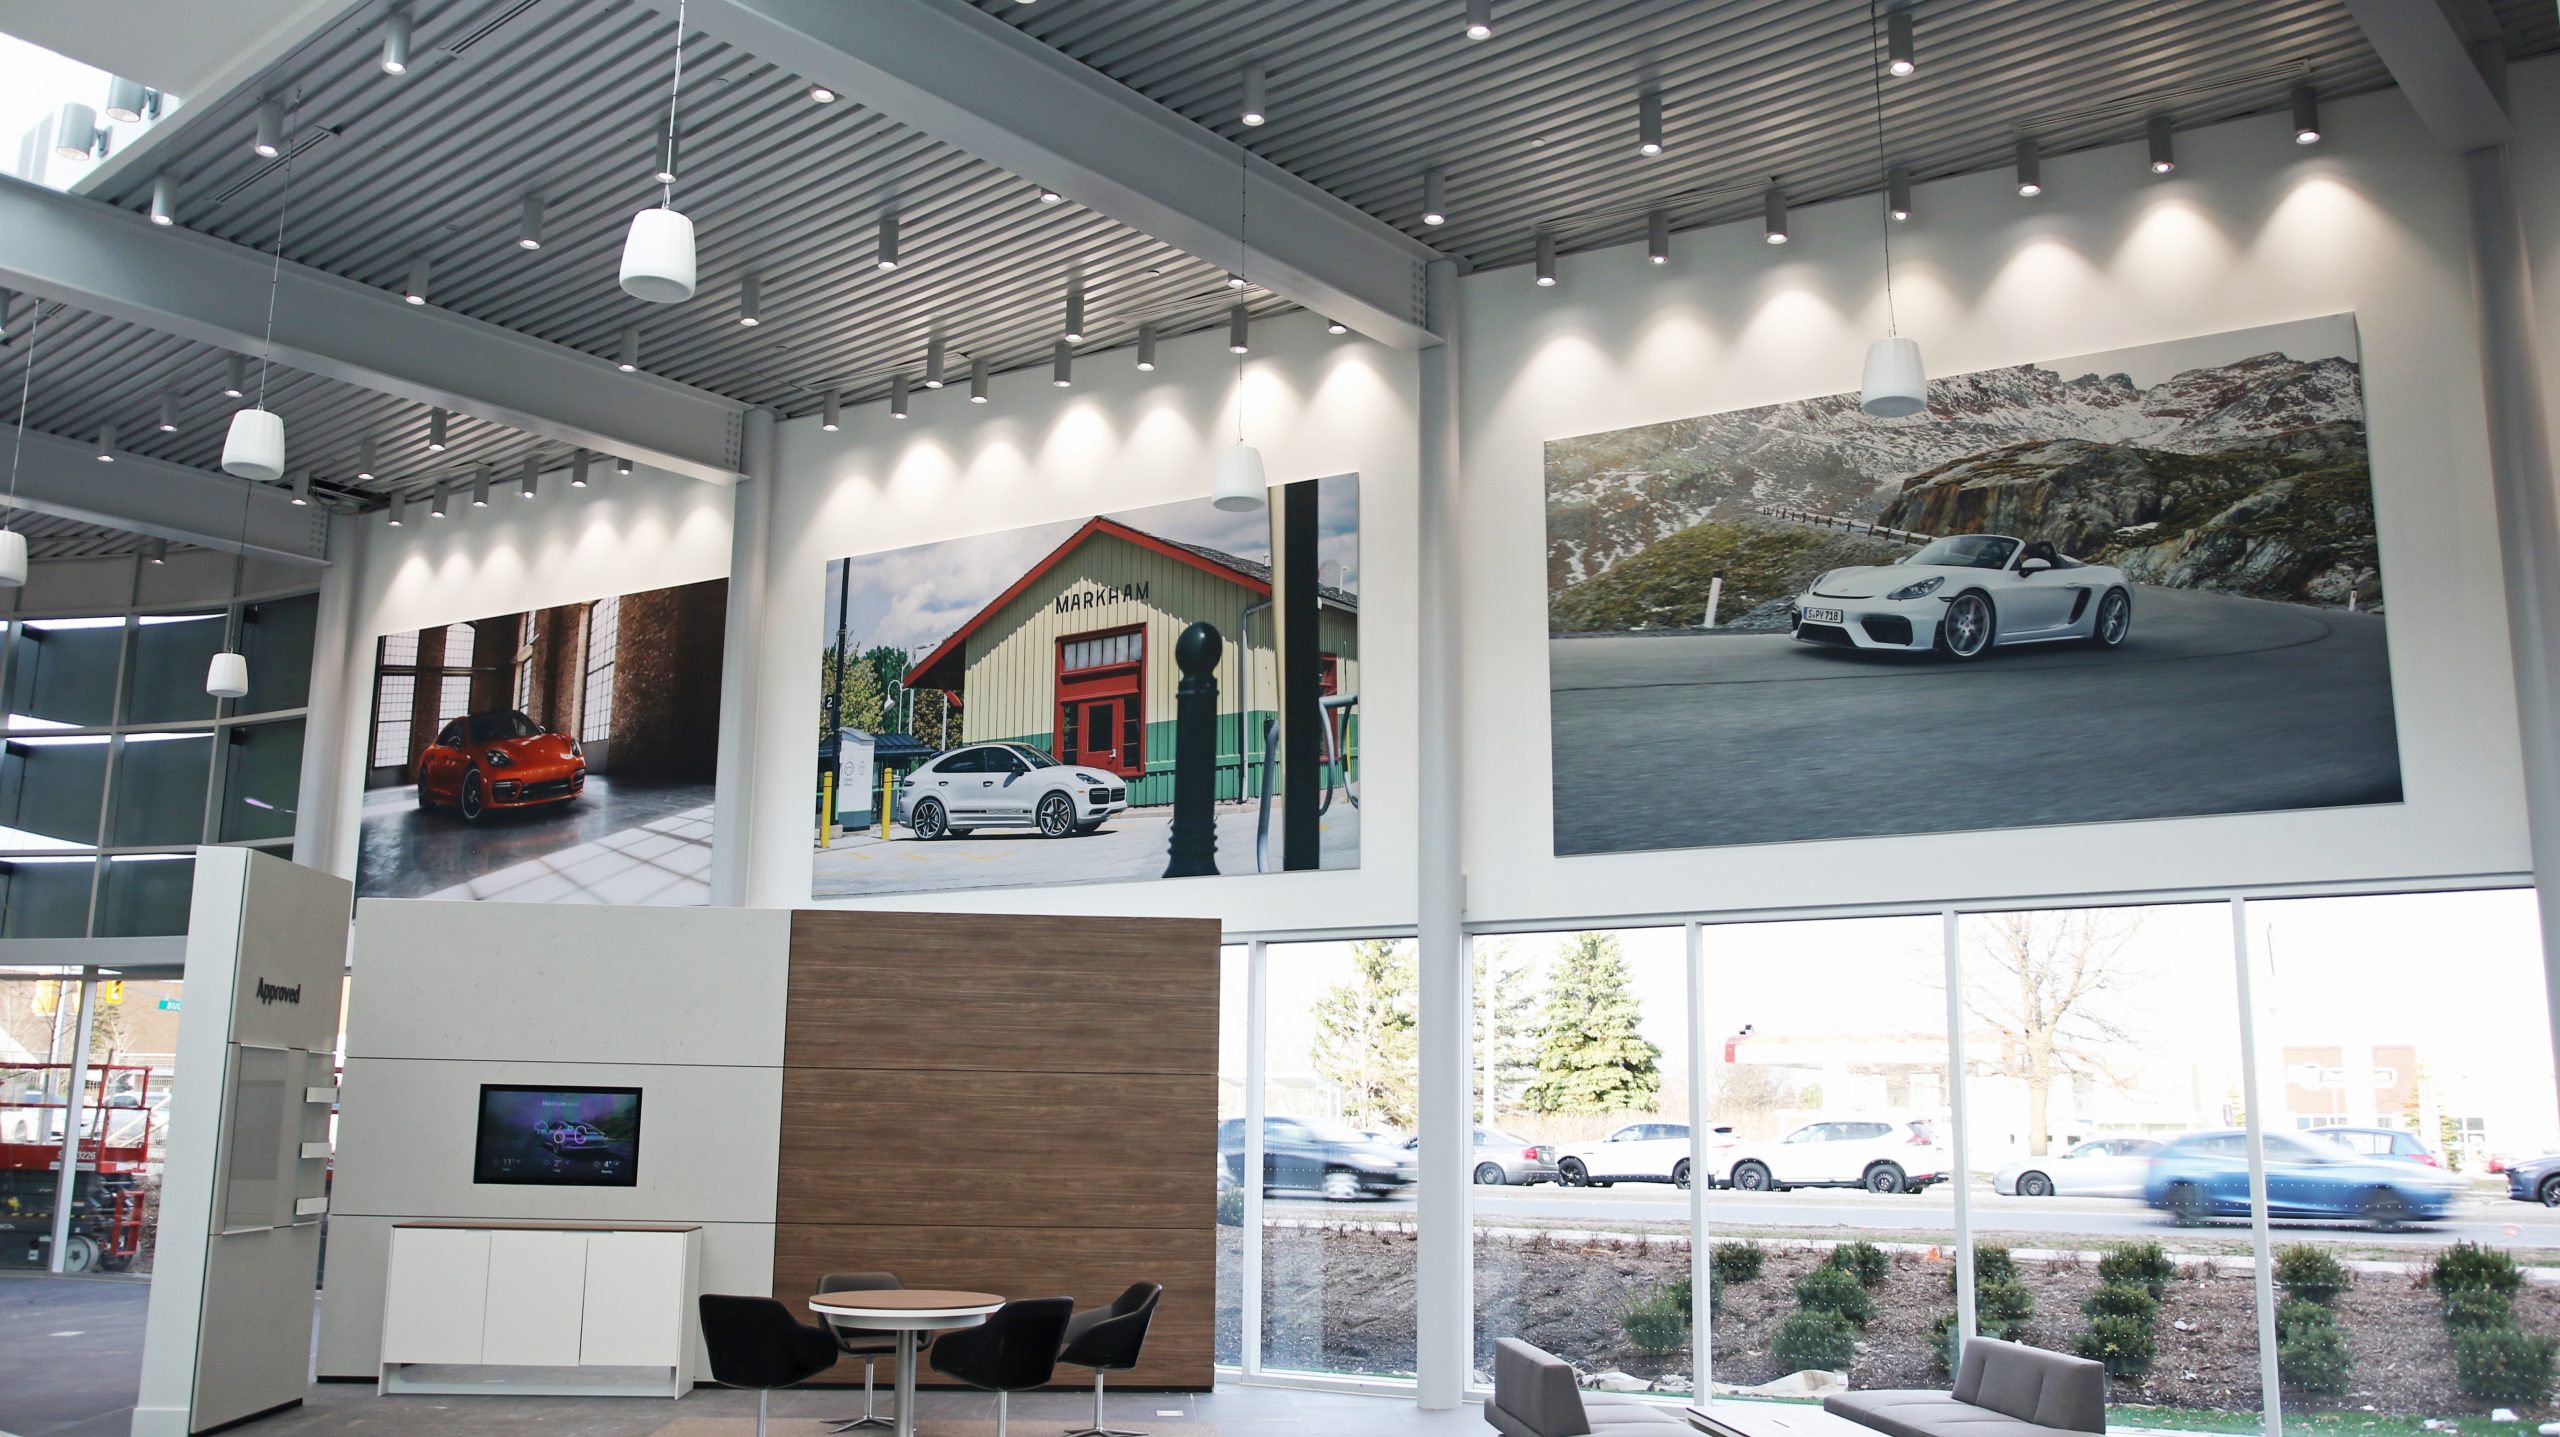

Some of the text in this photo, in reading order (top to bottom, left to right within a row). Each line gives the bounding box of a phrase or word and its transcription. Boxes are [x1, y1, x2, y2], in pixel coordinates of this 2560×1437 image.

[1056, 581, 1149, 614] MARKHAM
[1825, 610, 1838, 621] 718
[826, 696, 833, 708] 2
[256, 976, 301, 1005] Approved
